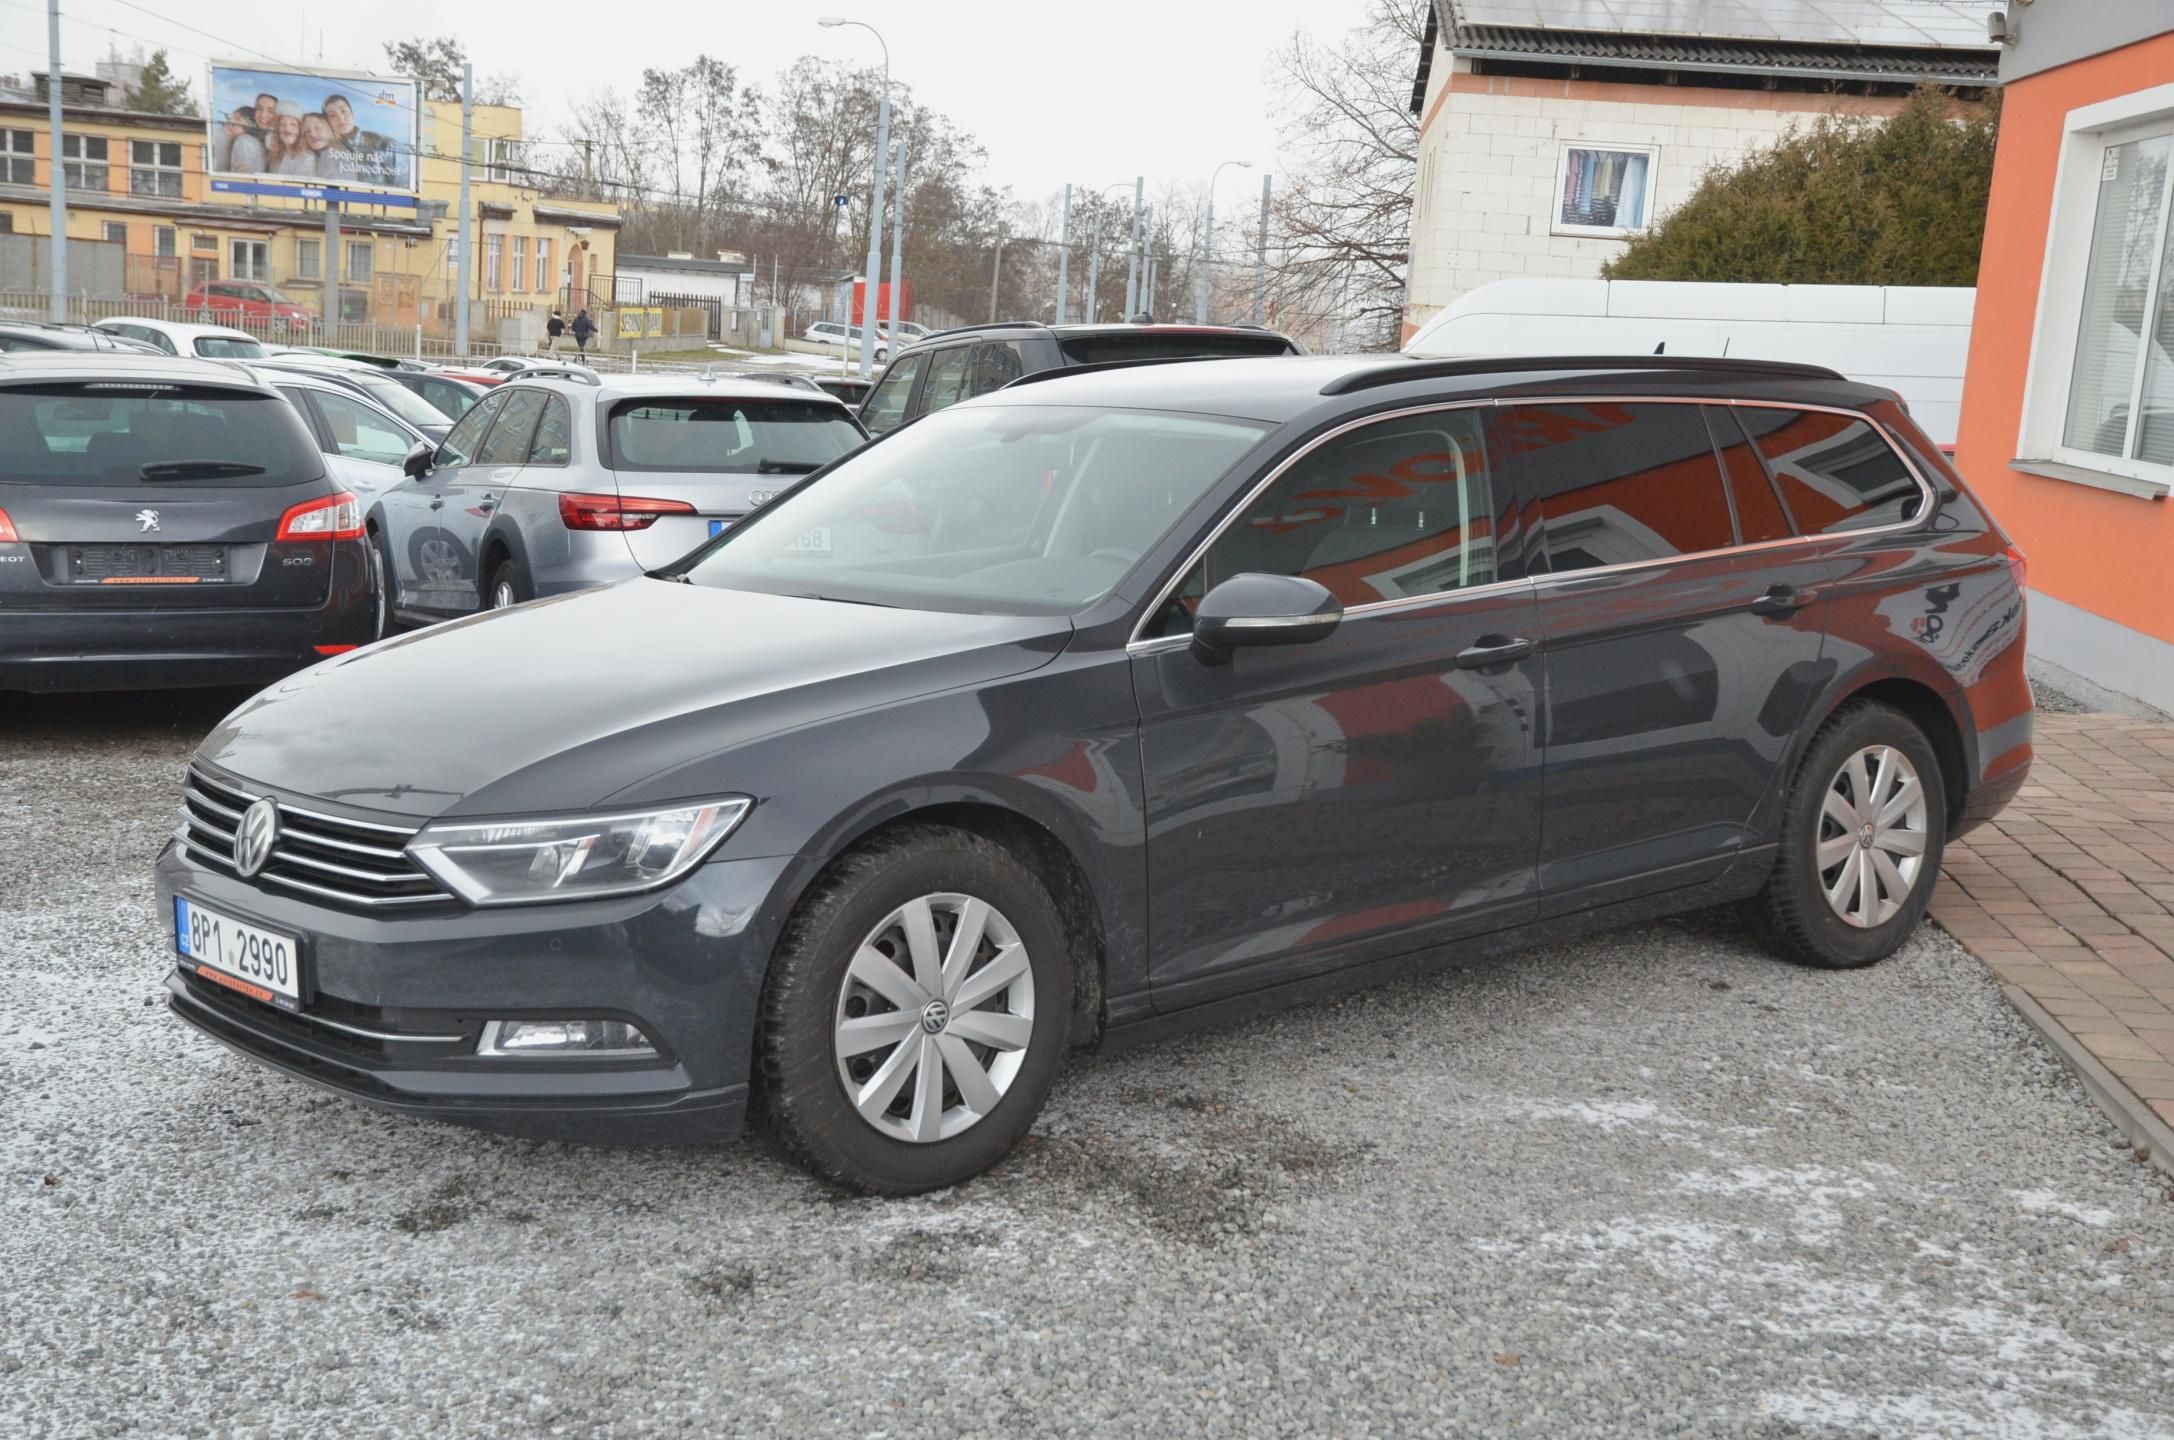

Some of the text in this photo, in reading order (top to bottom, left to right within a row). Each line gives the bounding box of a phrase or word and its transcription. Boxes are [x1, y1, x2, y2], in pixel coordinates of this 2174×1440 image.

[328, 147, 364, 162] Spojuje
[181, 933, 190, 947] CZ
[192, 910, 223, 963] 8P1
[236, 928, 288, 986] 2990
